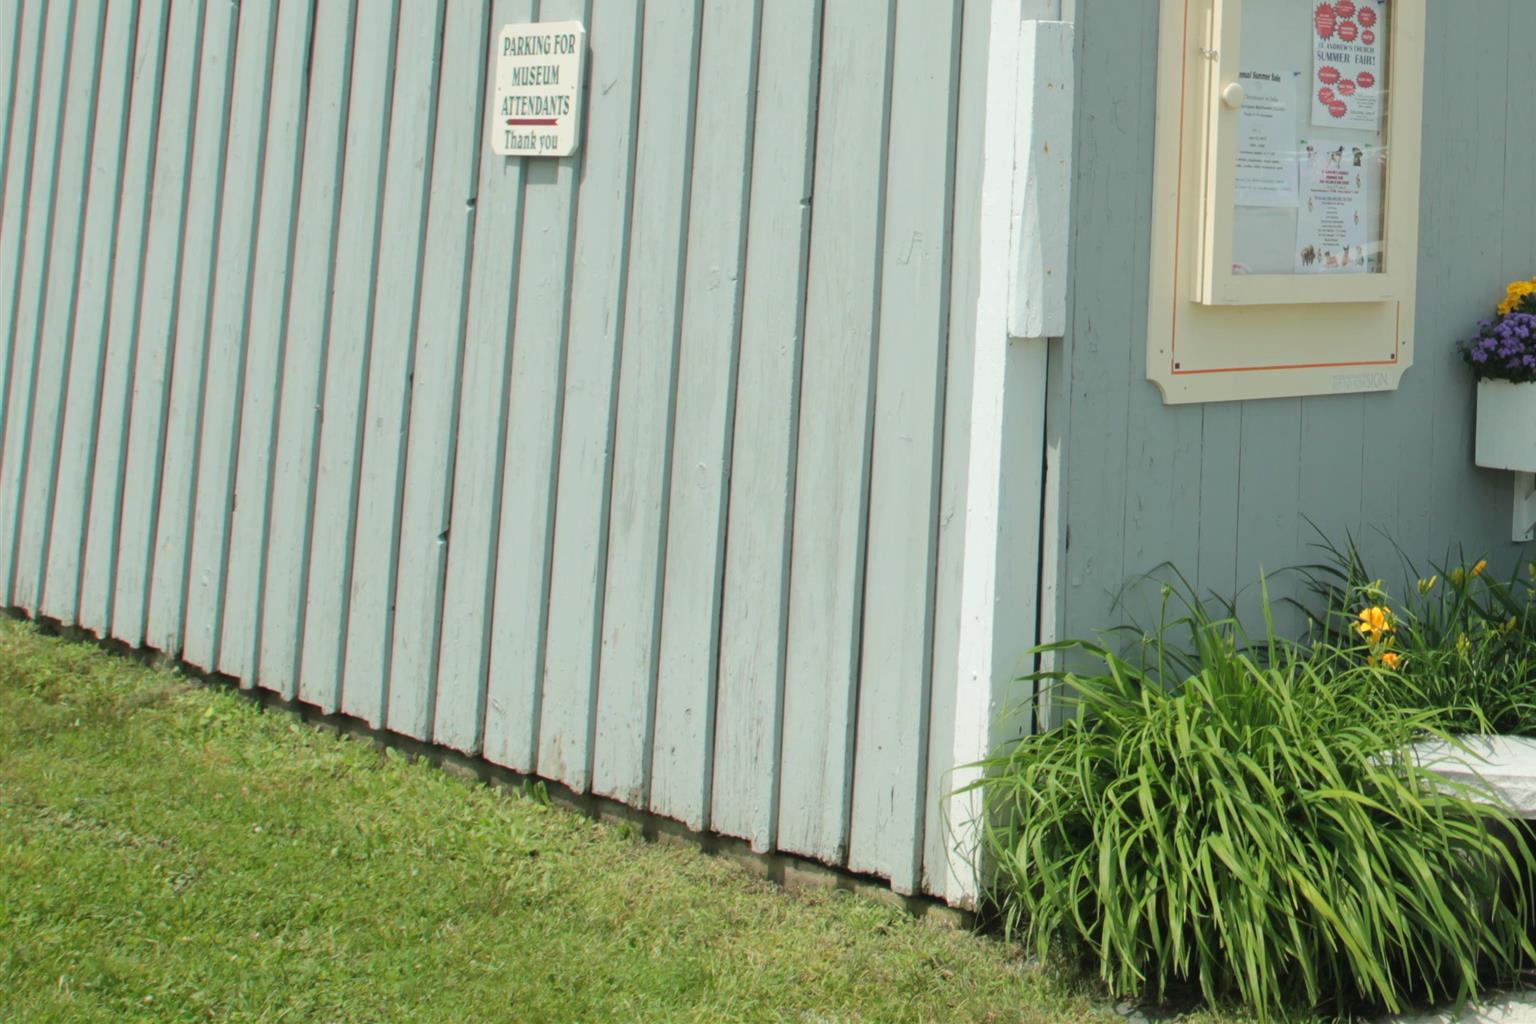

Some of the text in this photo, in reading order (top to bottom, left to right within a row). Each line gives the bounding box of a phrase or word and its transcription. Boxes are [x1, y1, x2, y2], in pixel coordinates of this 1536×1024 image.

[503, 34, 576, 57] PARKING FOR
[1317, 50, 1375, 65] SUMMER FAIR!
[511, 65, 560, 87] MUSEUM
[501, 95, 570, 117] ATTENDANTS
[504, 129, 559, 155] Thank you
